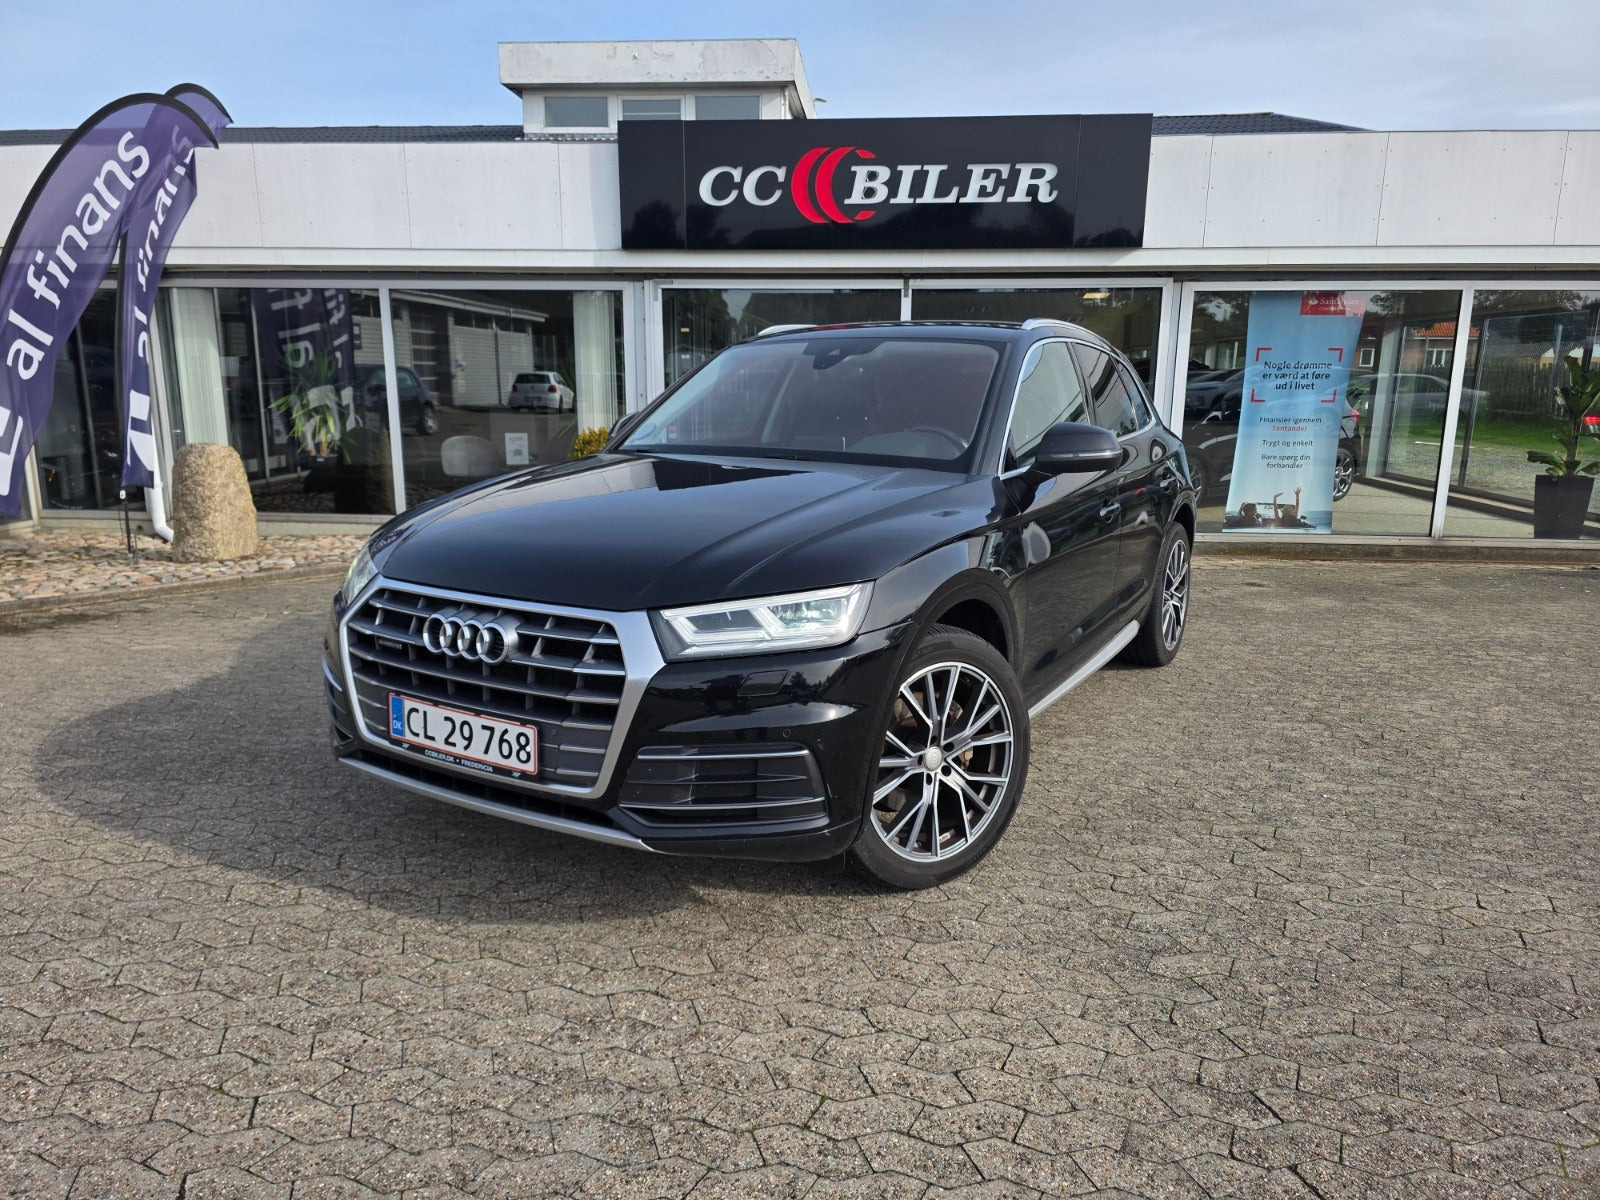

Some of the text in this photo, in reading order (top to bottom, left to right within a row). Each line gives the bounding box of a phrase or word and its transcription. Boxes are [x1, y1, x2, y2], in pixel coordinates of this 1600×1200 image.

[698, 162, 1059, 206] CC BILER
[6, 131, 150, 381] al finans
[1263, 361, 1333, 371] Nogle drømme
[1274, 371, 1299, 380] værd
[1300, 372, 1309, 380] at
[1311, 371, 1331, 380] føre
[1275, 381, 1287, 390] ud
[1294, 381, 1315, 390] livet
[1293, 417, 1322, 425] igennem
[1266, 461, 1303, 469] forhandler
[392, 719, 403, 730] DK
[406, 707, 532, 764] CL 29 768
